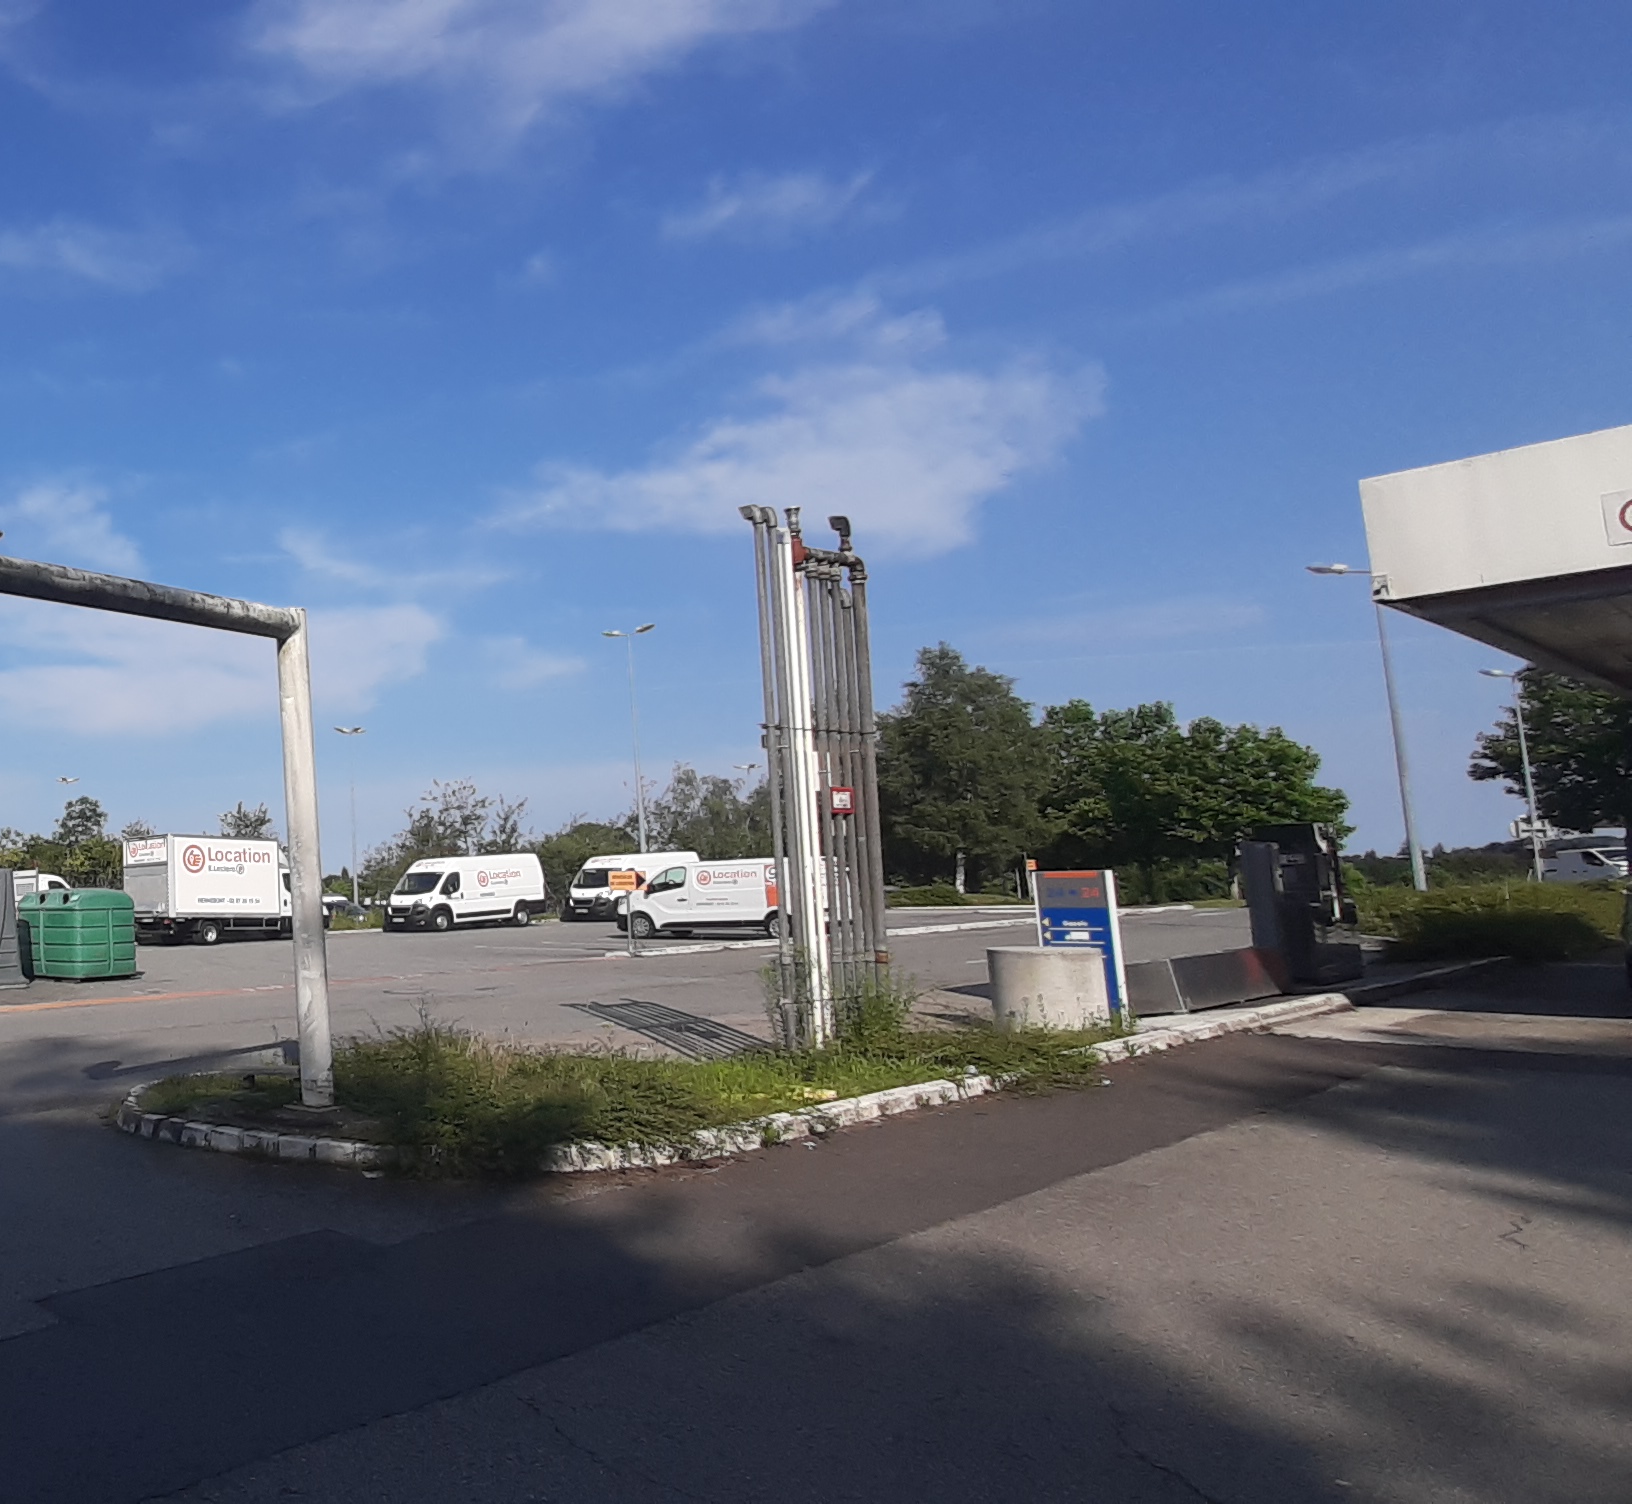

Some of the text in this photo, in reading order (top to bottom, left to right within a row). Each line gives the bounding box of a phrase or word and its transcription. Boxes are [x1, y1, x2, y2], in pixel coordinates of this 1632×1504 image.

[208, 846, 270, 863] Location
[489, 869, 521, 879] Location
[713, 869, 757, 878] Location
